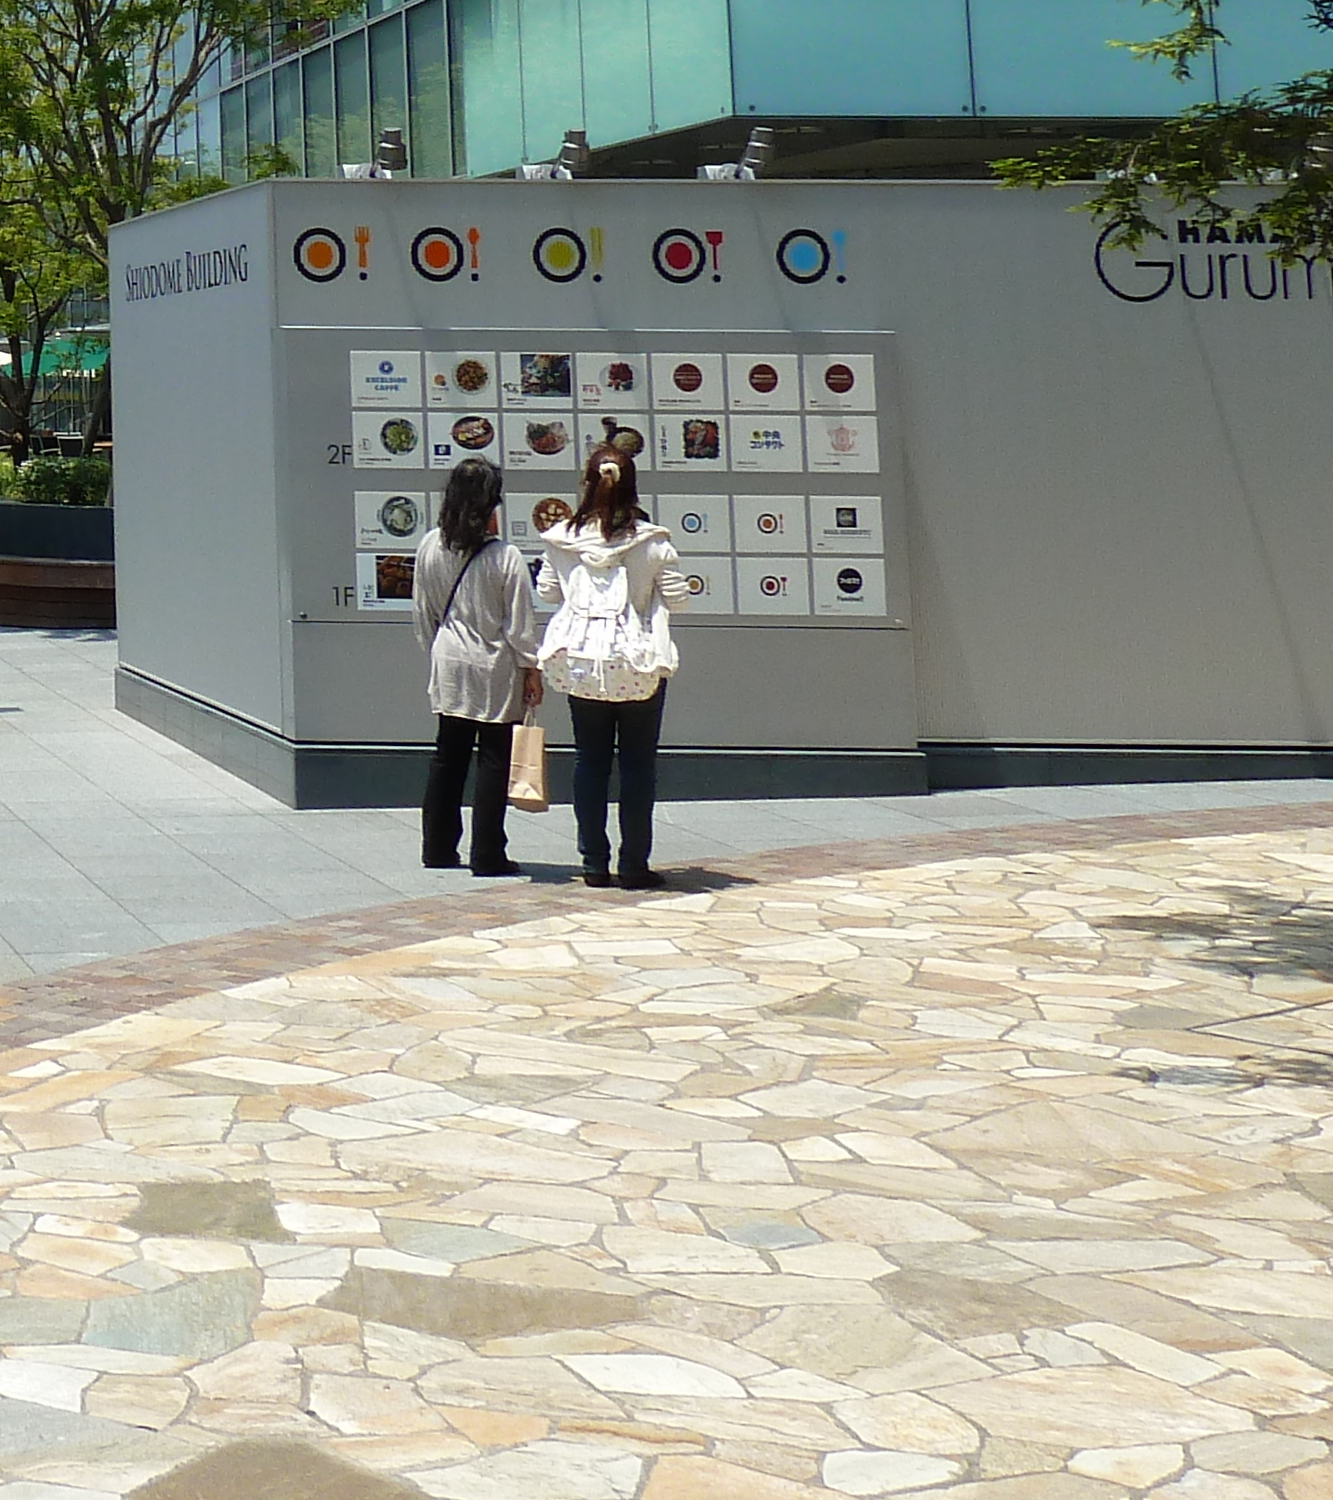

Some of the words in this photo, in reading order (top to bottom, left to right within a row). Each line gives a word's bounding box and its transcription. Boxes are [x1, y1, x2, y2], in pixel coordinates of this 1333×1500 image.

[126, 259, 182, 302] SHIODOME
[185, 244, 249, 292] BUILDING
[327, 444, 353, 465] 2F
[332, 586, 355, 607] 1F
